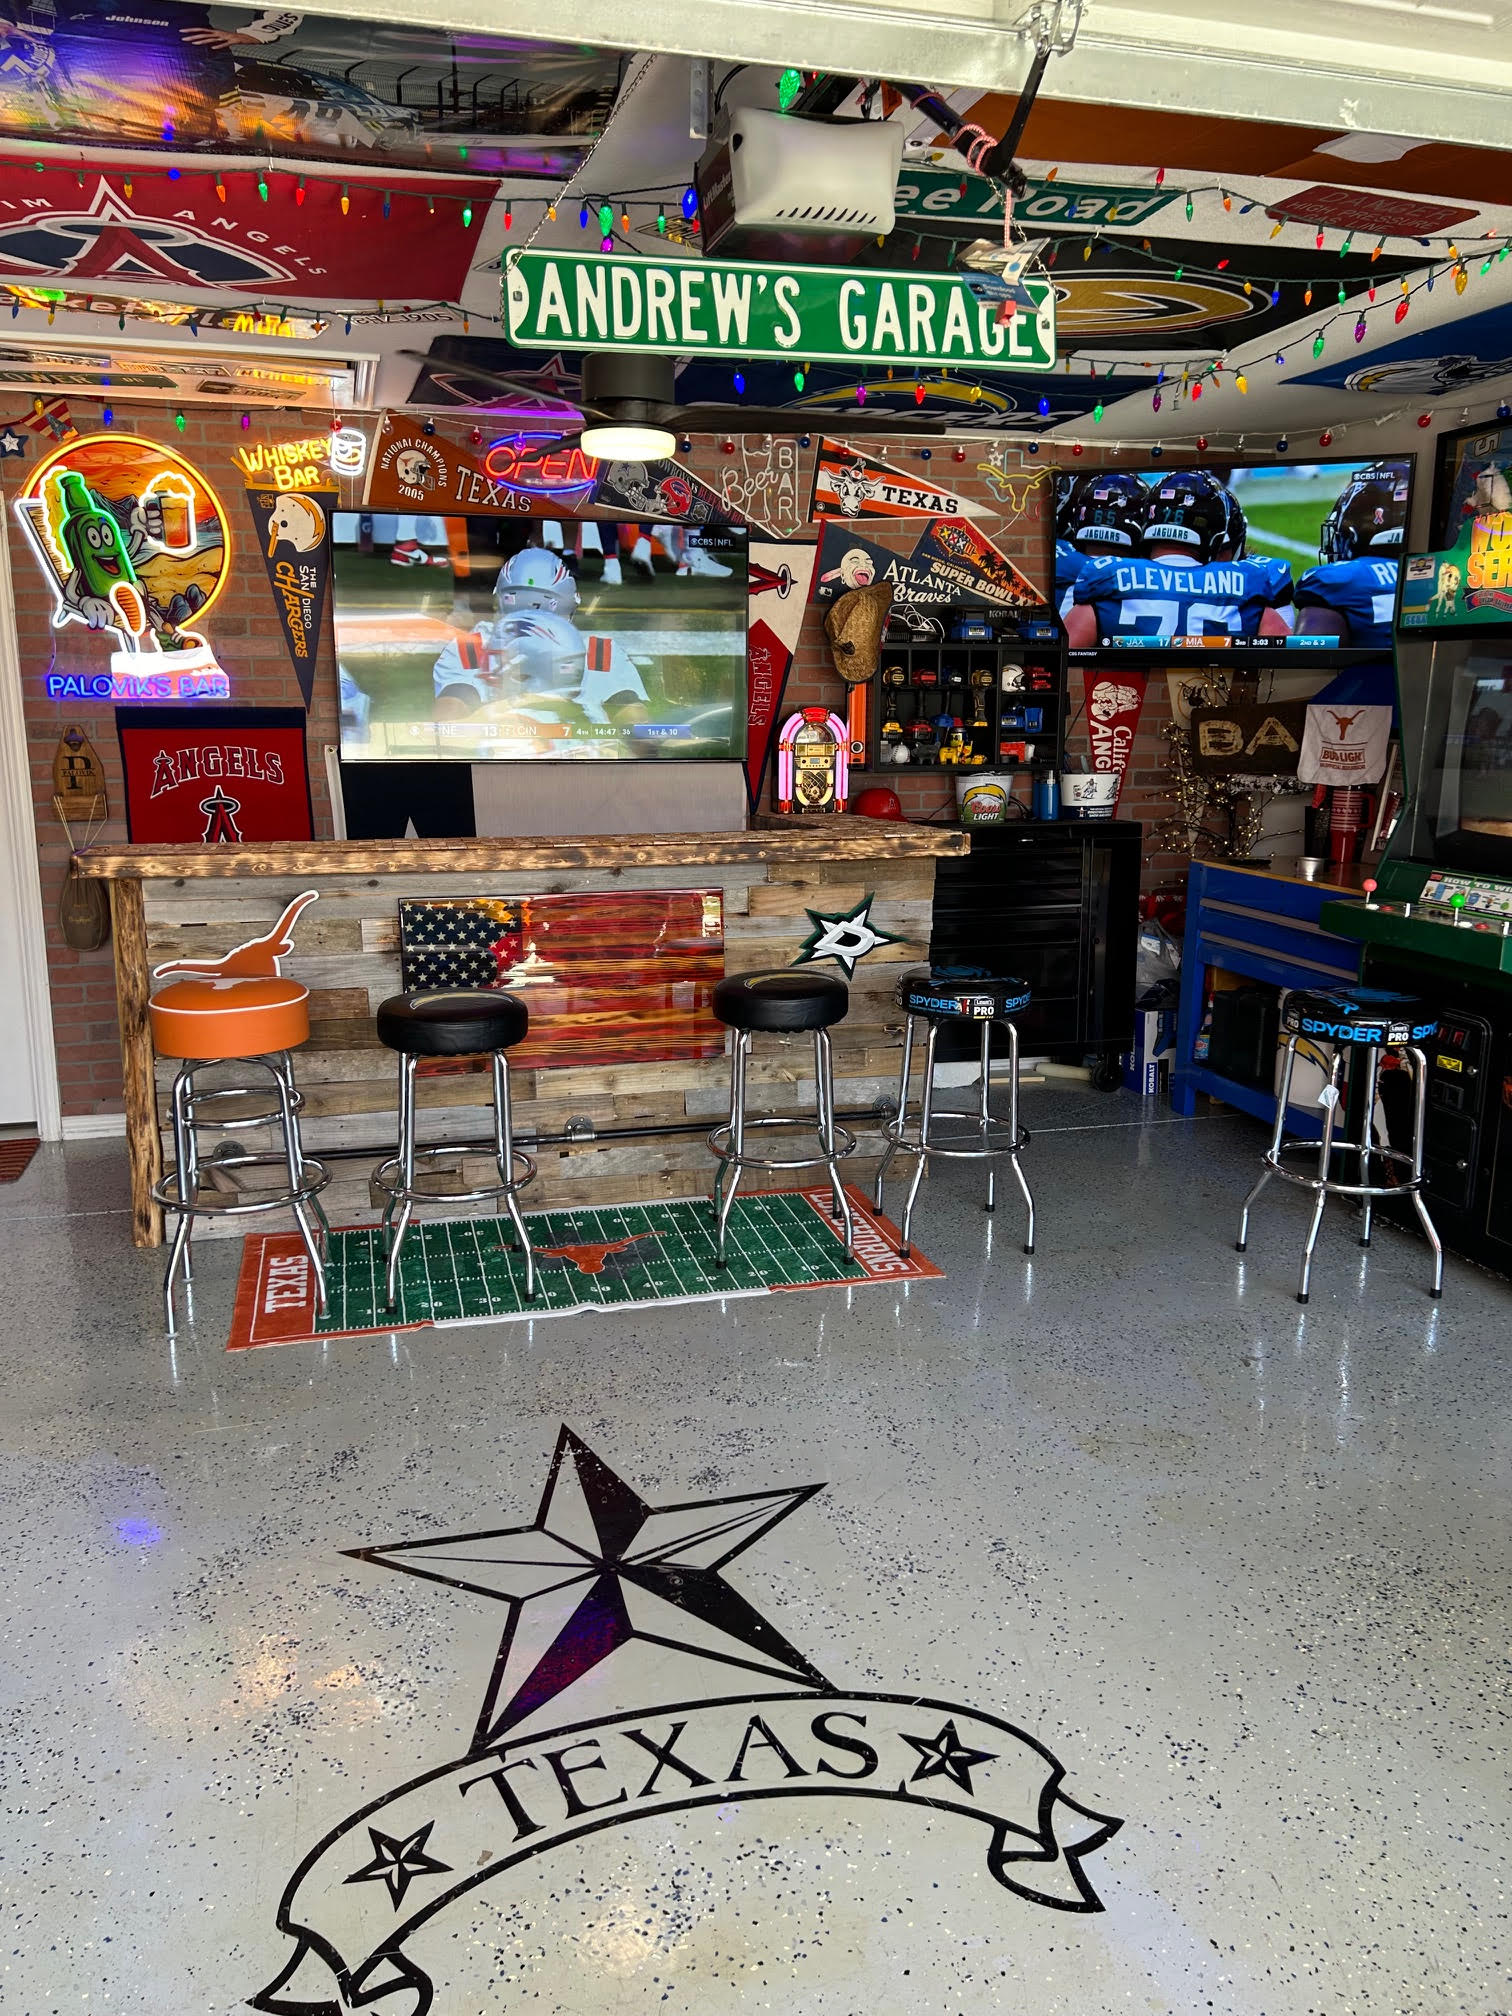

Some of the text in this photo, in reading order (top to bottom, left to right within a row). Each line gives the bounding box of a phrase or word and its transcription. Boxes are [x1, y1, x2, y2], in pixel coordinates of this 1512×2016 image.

[105, 14, 170, 27] Johnson
[1287, 202, 1440, 231] HIGH PRESSURE
[1319, 192, 1458, 221] DANGER
[173, 209, 327, 276] ANGELS
[536, 261, 1034, 357] ANDREW'S GARAGE
[238, 437, 333, 473] WHISKEY
[380, 437, 448, 488] NATIONAL CHAMPIONS
[485, 446, 600, 481] OPEN
[273, 464, 321, 491] BAR
[455, 465, 533, 513] TEXAS
[722, 465, 779, 512] Beer
[777, 446, 794, 521] BAR
[1360, 471, 1396, 480] CBS NFL
[397, 484, 425, 502] 2005
[881, 485, 959, 515] TEXAS
[699, 539, 733, 547] CBS NFL
[1084, 528, 1121, 542] JAGUARS
[1152, 527, 1189, 540] JAGUARS
[309, 567, 317, 589] THE
[883, 558, 962, 597] ATLANTA
[930, 561, 976, 587] SUPER
[975, 578, 1015, 603] BOWL
[1116, 566, 1245, 597] CLEVELAND
[299, 565, 313, 630] SAN DIEGO
[892, 582, 952, 603] Braves
[273, 561, 316, 658] CHARGERS
[1127, 638, 1144, 647] JAX
[1158, 638, 1171, 647] 17
[1185, 638, 1204, 647] MIA
[1223, 638, 1231, 647] 7
[1252, 638, 1269, 647] 3:03
[1276, 639, 1284, 647] 17
[48, 674, 228, 698] PALOVIK'S BAR
[748, 645, 773, 727] ANGELS
[442, 726, 458, 736] NE
[483, 726, 498, 737] 13
[518, 726, 538, 736] CIN
[562, 726, 570, 737] 7
[594, 728, 617, 736] 14:47
[150, 745, 285, 800] ANGELS
[970, 801, 1001, 814] Coors
[973, 812, 999, 822] LIGHT
[1444, 876, 1471, 887] HOW
[1474, 880, 1491, 890] TO
[908, 993, 958, 1010] SPYDER
[973, 1006, 995, 1016] PRO
[1286, 1016, 1300, 1029] PRO
[1301, 1017, 1383, 1043] SPYDER
[1387, 1032, 1410, 1042] PRO
[1148, 1064, 1156, 1094] KOBALT
[264, 1254, 310, 1315] TEXAS
[458, 1708, 880, 1845] TEXAS
